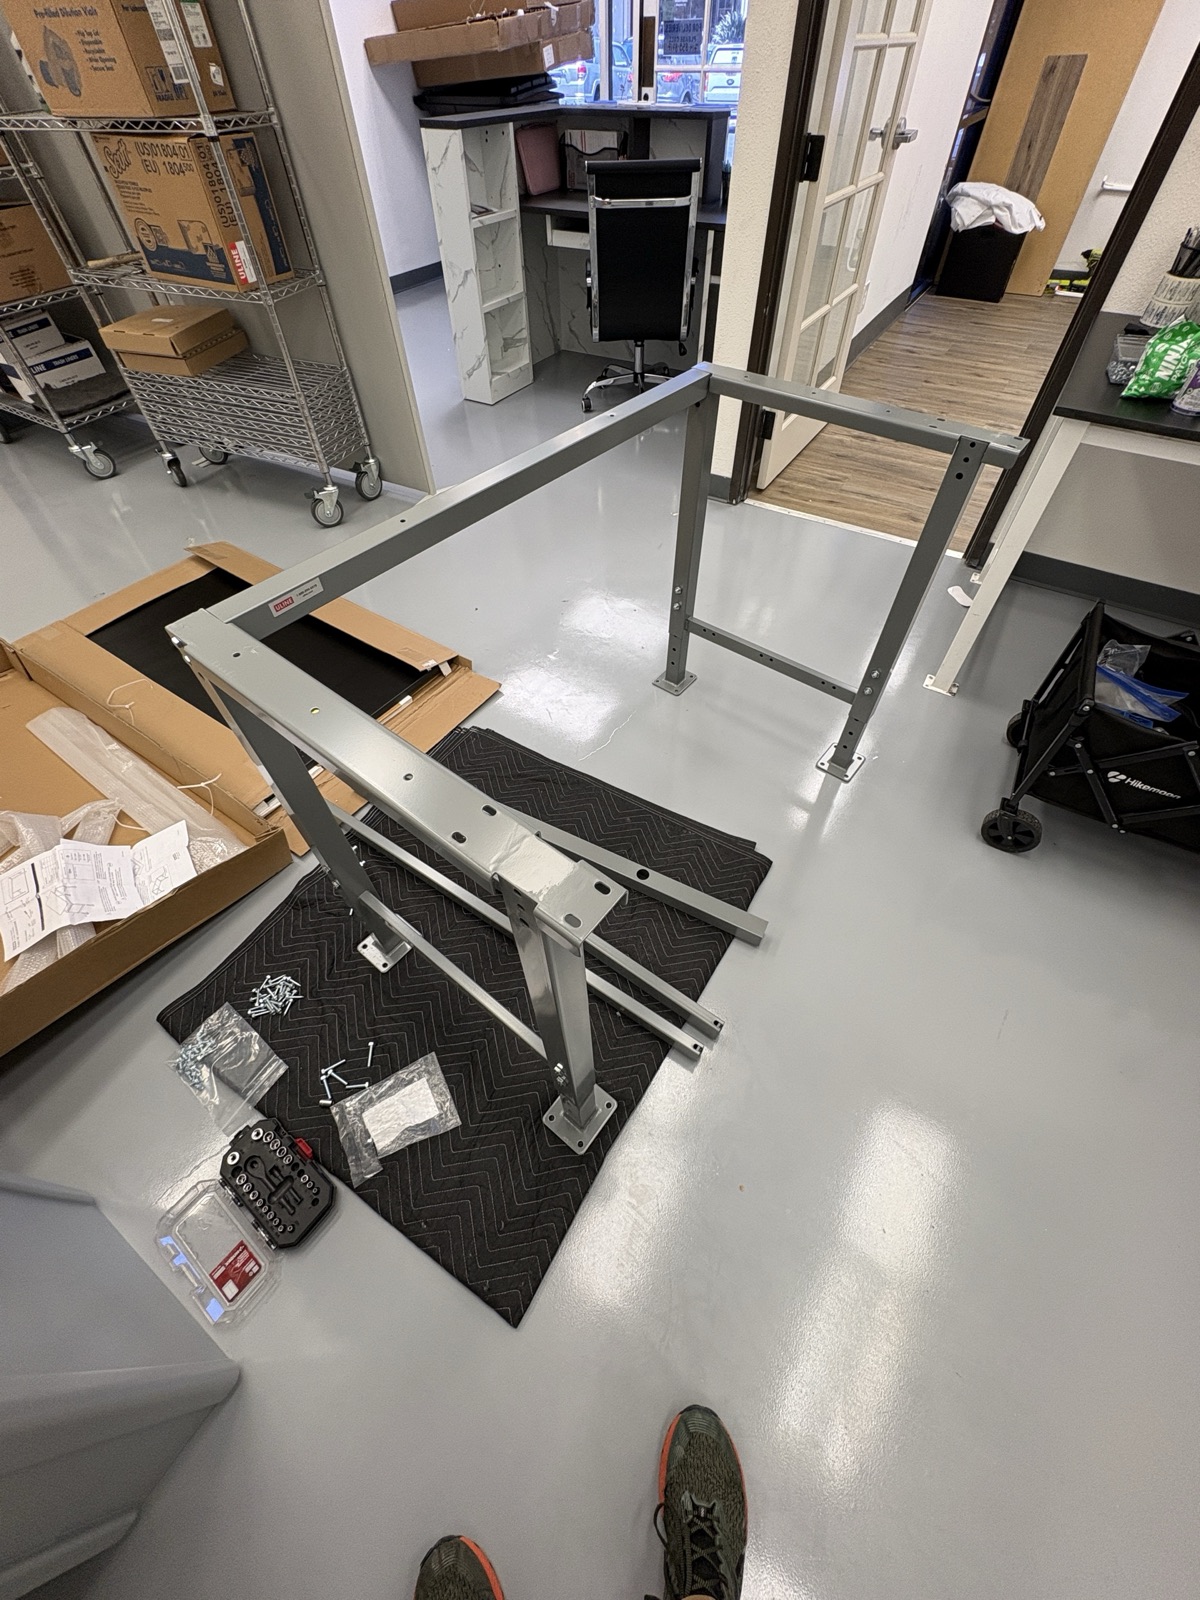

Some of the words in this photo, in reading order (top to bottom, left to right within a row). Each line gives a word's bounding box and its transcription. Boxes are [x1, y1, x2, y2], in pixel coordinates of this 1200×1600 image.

[141, 158, 161, 175] (EU)
[230, 249, 246, 280] ULINE
[30, 364, 46, 374] LINE
[275, 597, 292, 611] ULINE
